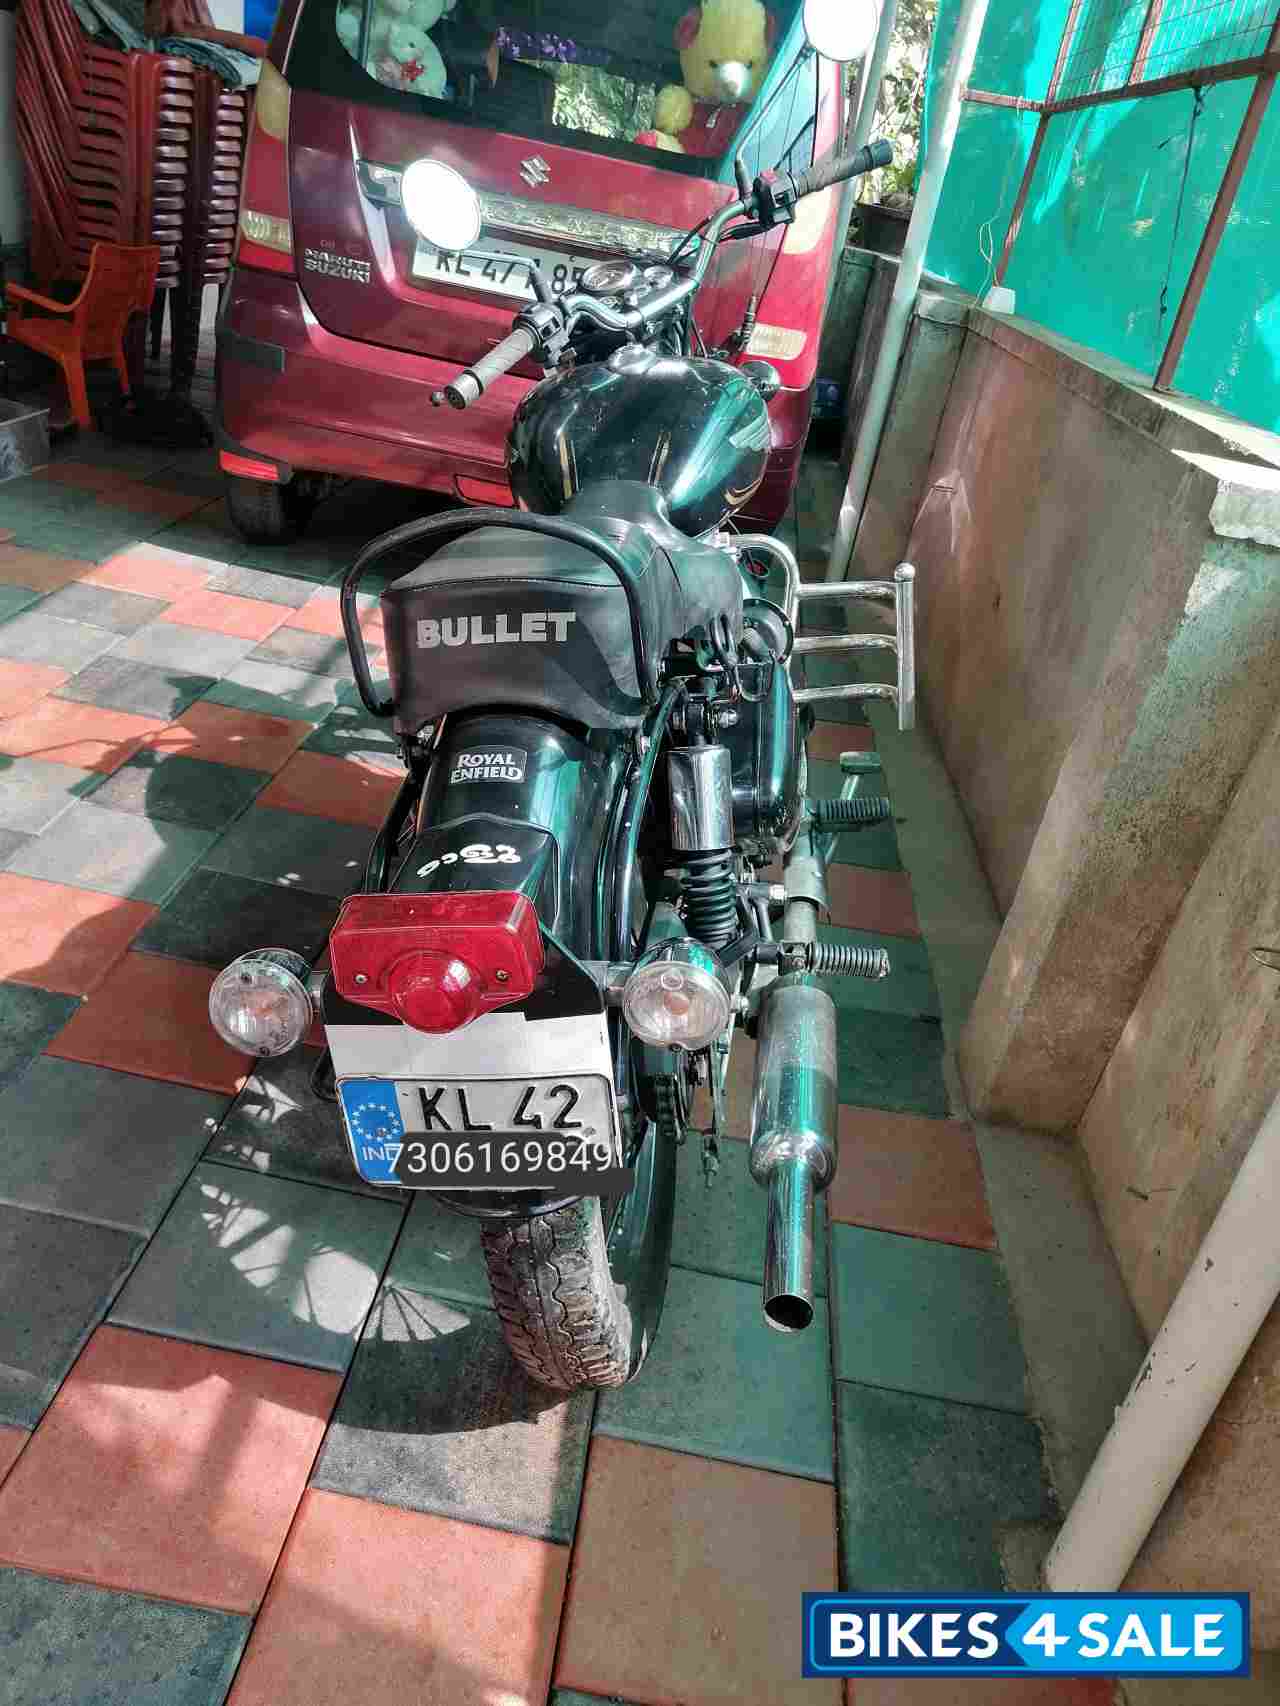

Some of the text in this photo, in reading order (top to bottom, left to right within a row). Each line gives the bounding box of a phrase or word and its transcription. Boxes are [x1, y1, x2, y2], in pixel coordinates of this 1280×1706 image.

[304, 257, 371, 283] SUZUKI
[416, 611, 576, 649] BULLET
[457, 753, 516, 768] ROYAL
[450, 766, 523, 784] ENFIELD
[417, 1084, 583, 1131] KL 42
